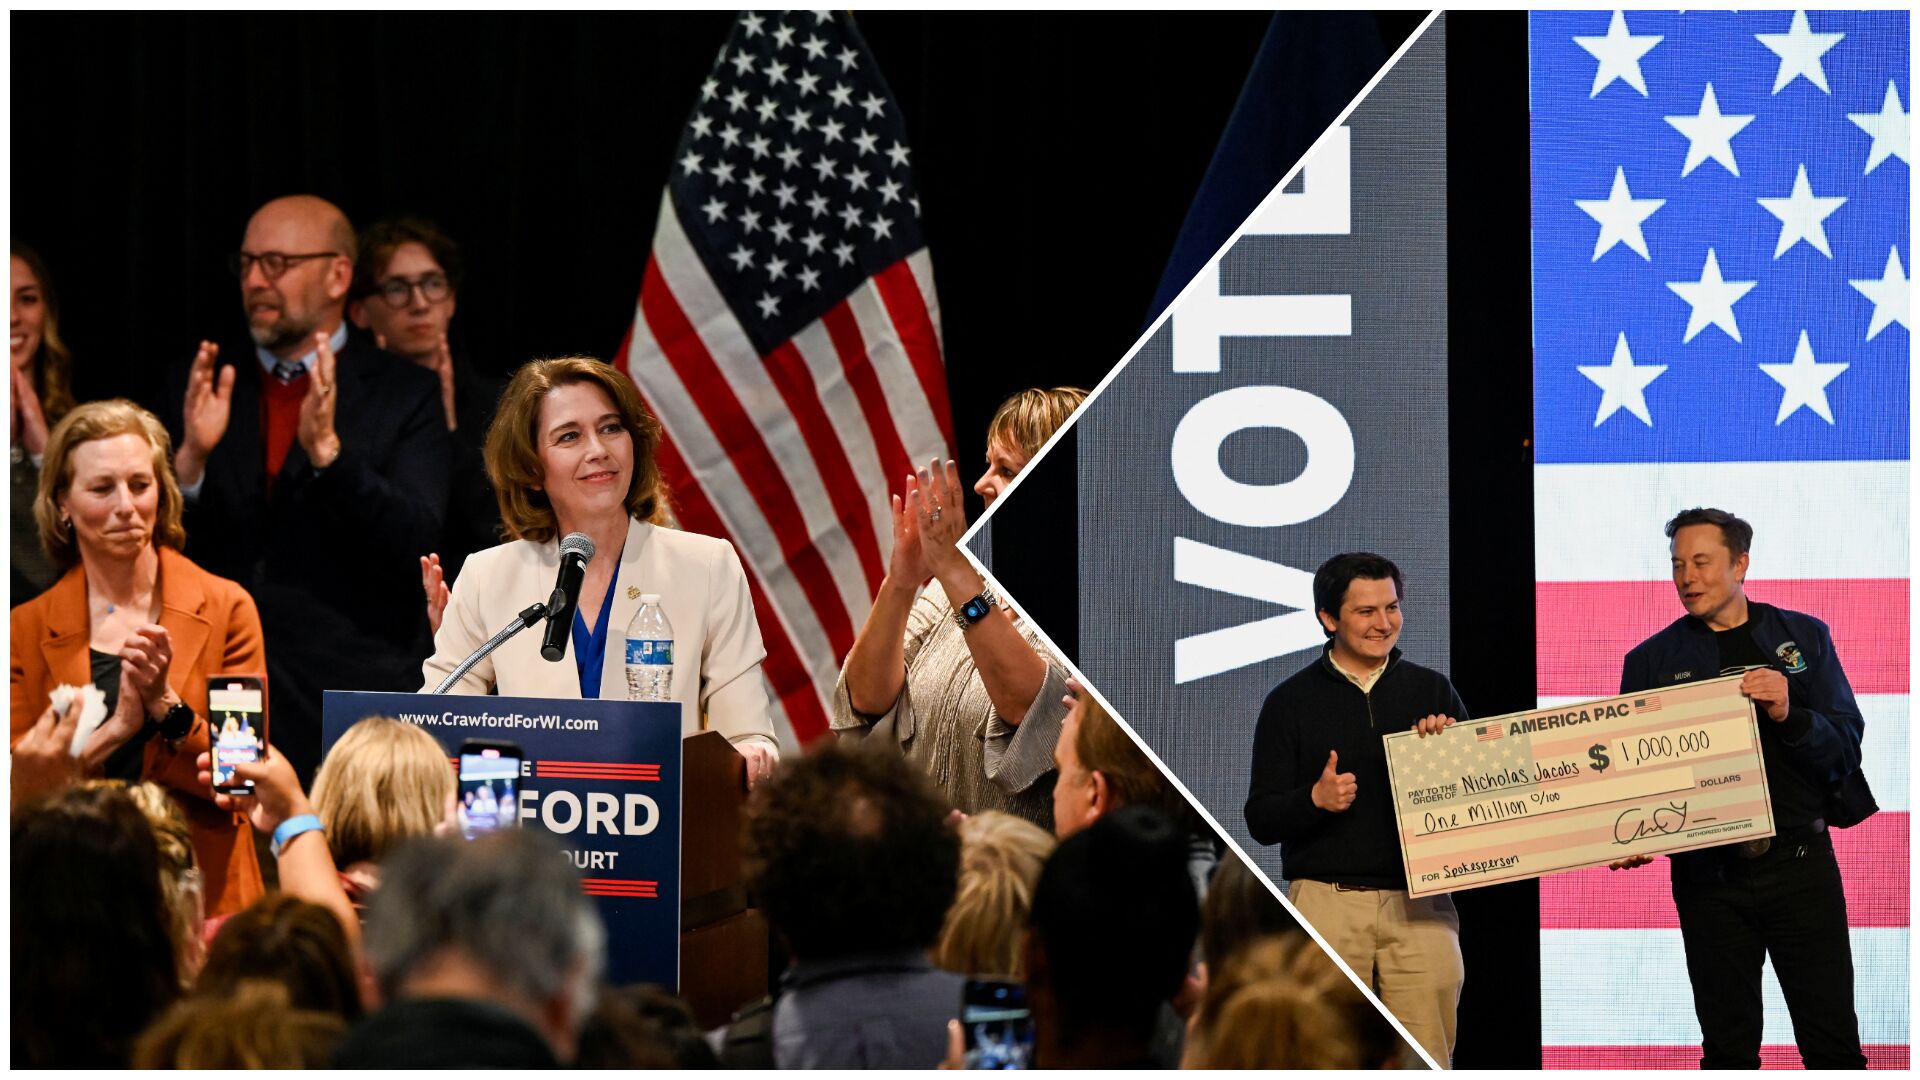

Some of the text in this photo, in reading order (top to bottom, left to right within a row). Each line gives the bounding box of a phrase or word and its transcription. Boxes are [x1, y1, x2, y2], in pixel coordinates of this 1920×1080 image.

[1674, 671, 1692, 680] MUSK
[399, 711, 599, 731] www.CrawfordForWI.com
[1509, 703, 1630, 736] AMERICA PAC
[1588, 743, 1610, 773] $
[1621, 730, 1710, 766] 1,000,000
[1461, 761, 1580, 794] Nicholas Jacobs
[1700, 774, 1742, 788] DOLLARS
[1408, 783, 1457, 799] PAY TO THE
[1412, 791, 1457, 805] ORDER OF
[1424, 812, 1459, 833] One
[1468, 800, 1528, 822] Million
[1686, 822, 1753, 839] AUTHORIZED SIGNATURE
[1421, 872, 1440, 882] FOR
[1443, 855, 1520, 879] Spokesperson
